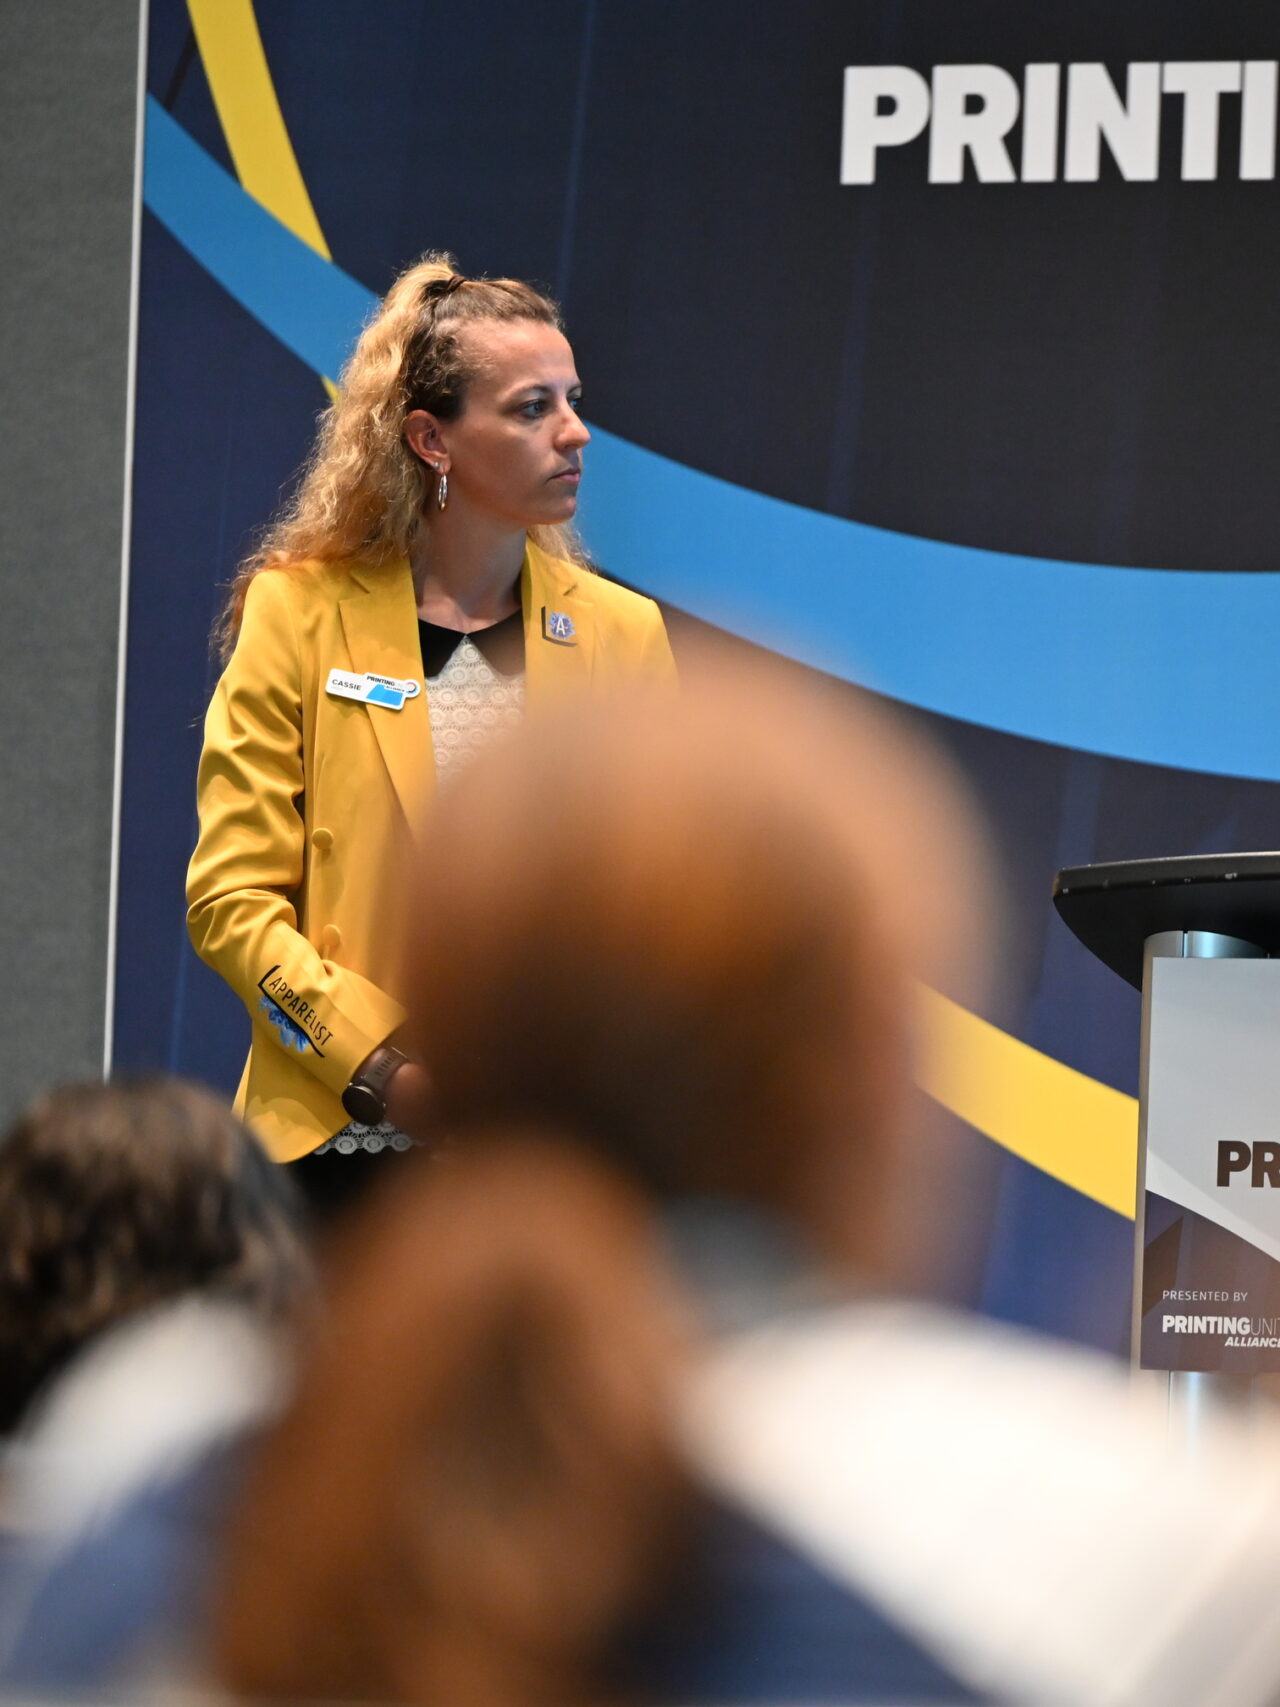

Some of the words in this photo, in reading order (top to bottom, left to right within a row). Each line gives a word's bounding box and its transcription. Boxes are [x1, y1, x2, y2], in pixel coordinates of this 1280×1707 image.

[555, 616, 566, 635] A
[331, 679, 362, 691] CASSIE
[366, 675, 396, 687] PRINTING
[1162, 1290, 1229, 1301] PRESENTED
[1233, 1291, 1249, 1302] BY
